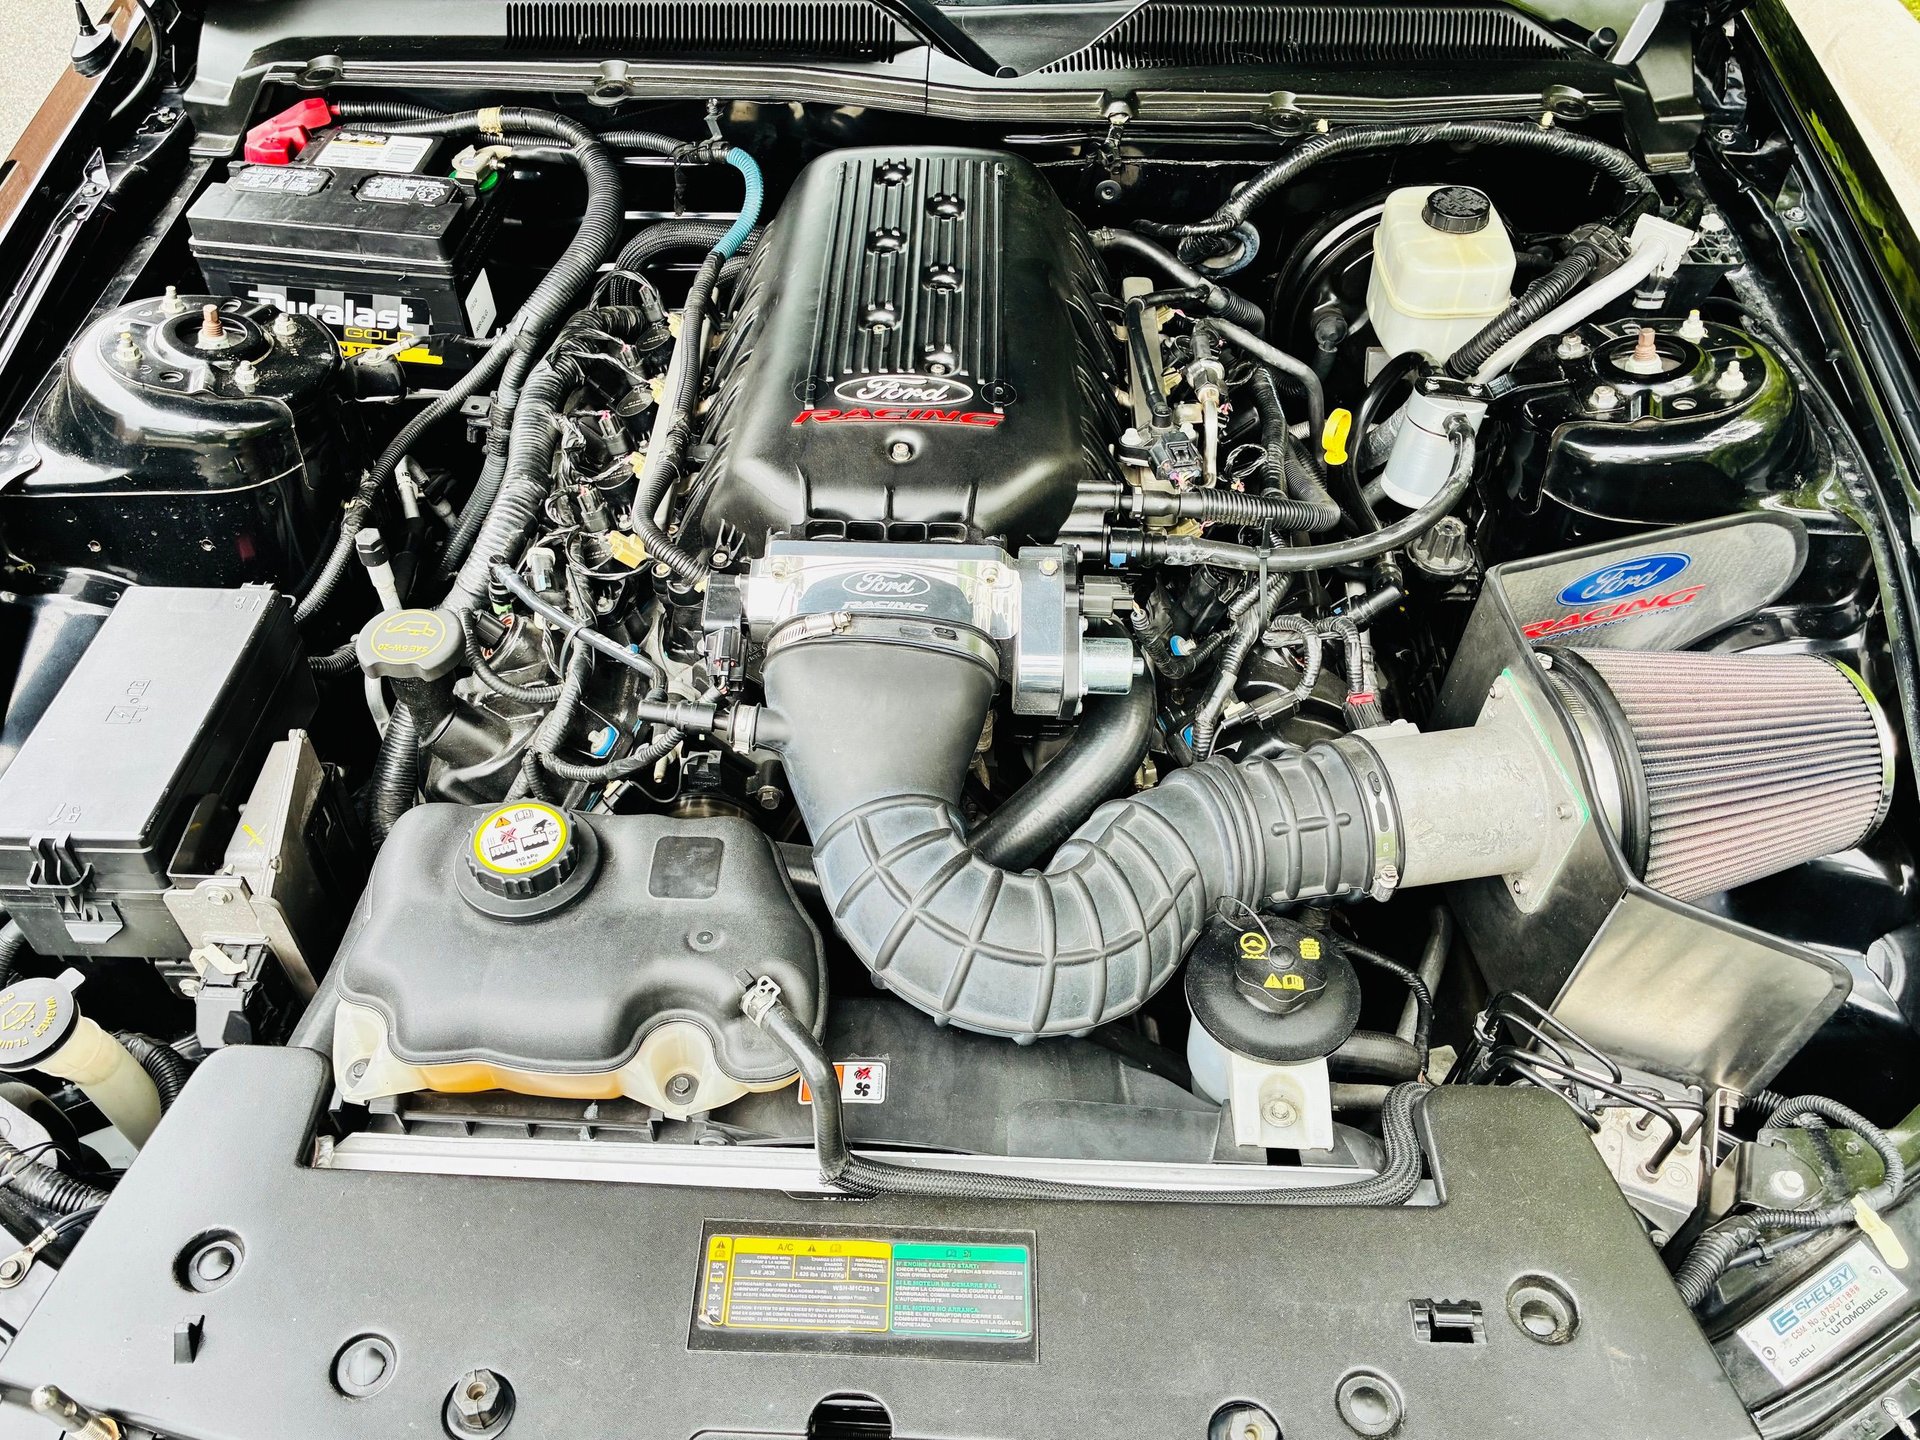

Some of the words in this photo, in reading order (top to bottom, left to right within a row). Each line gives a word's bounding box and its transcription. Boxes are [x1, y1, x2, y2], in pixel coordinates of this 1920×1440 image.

[857, 378, 950, 400] Ford
[792, 408, 1006, 427] RACING
[856, 572, 916, 594] Ford
[1581, 562, 1667, 599] Ford
[841, 601, 928, 612] RACING
[1522, 584, 1706, 638] RACING
[0, 1037, 29, 1049] FLUI
[778, 1243, 794, 1251] A/C
[1795, 1267, 1850, 1314] SHELBY
[1845, 1300, 1856, 1312] GT
